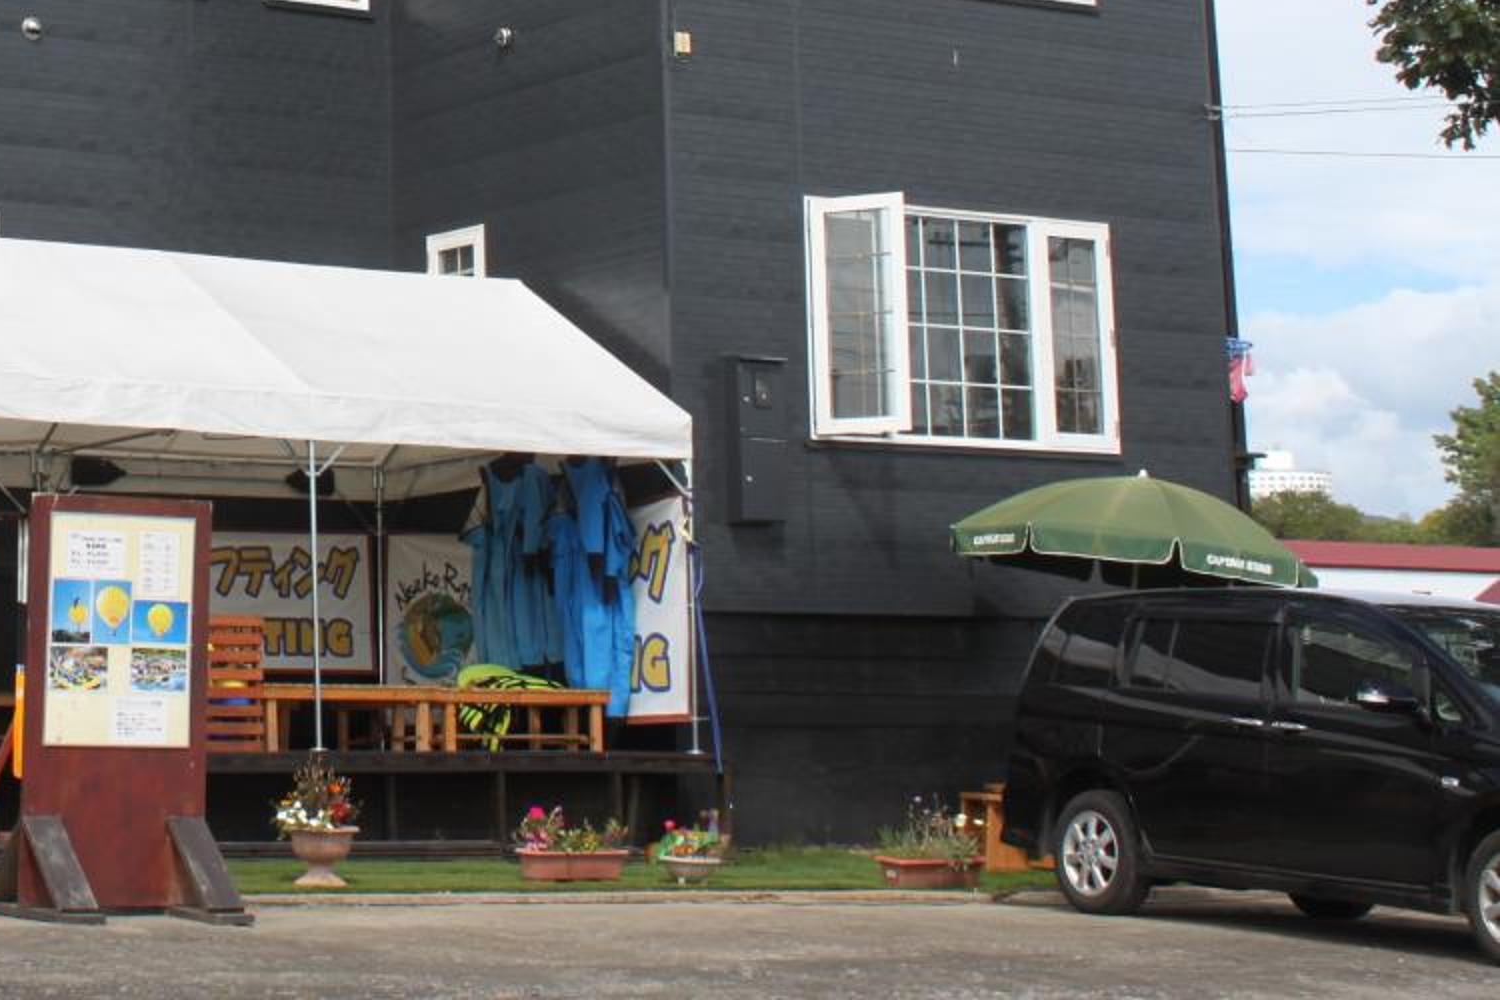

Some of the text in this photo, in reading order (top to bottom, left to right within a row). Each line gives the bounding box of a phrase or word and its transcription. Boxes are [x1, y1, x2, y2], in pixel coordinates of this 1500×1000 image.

[211, 545, 360, 600] フティング
[262, 616, 354, 658] TING
